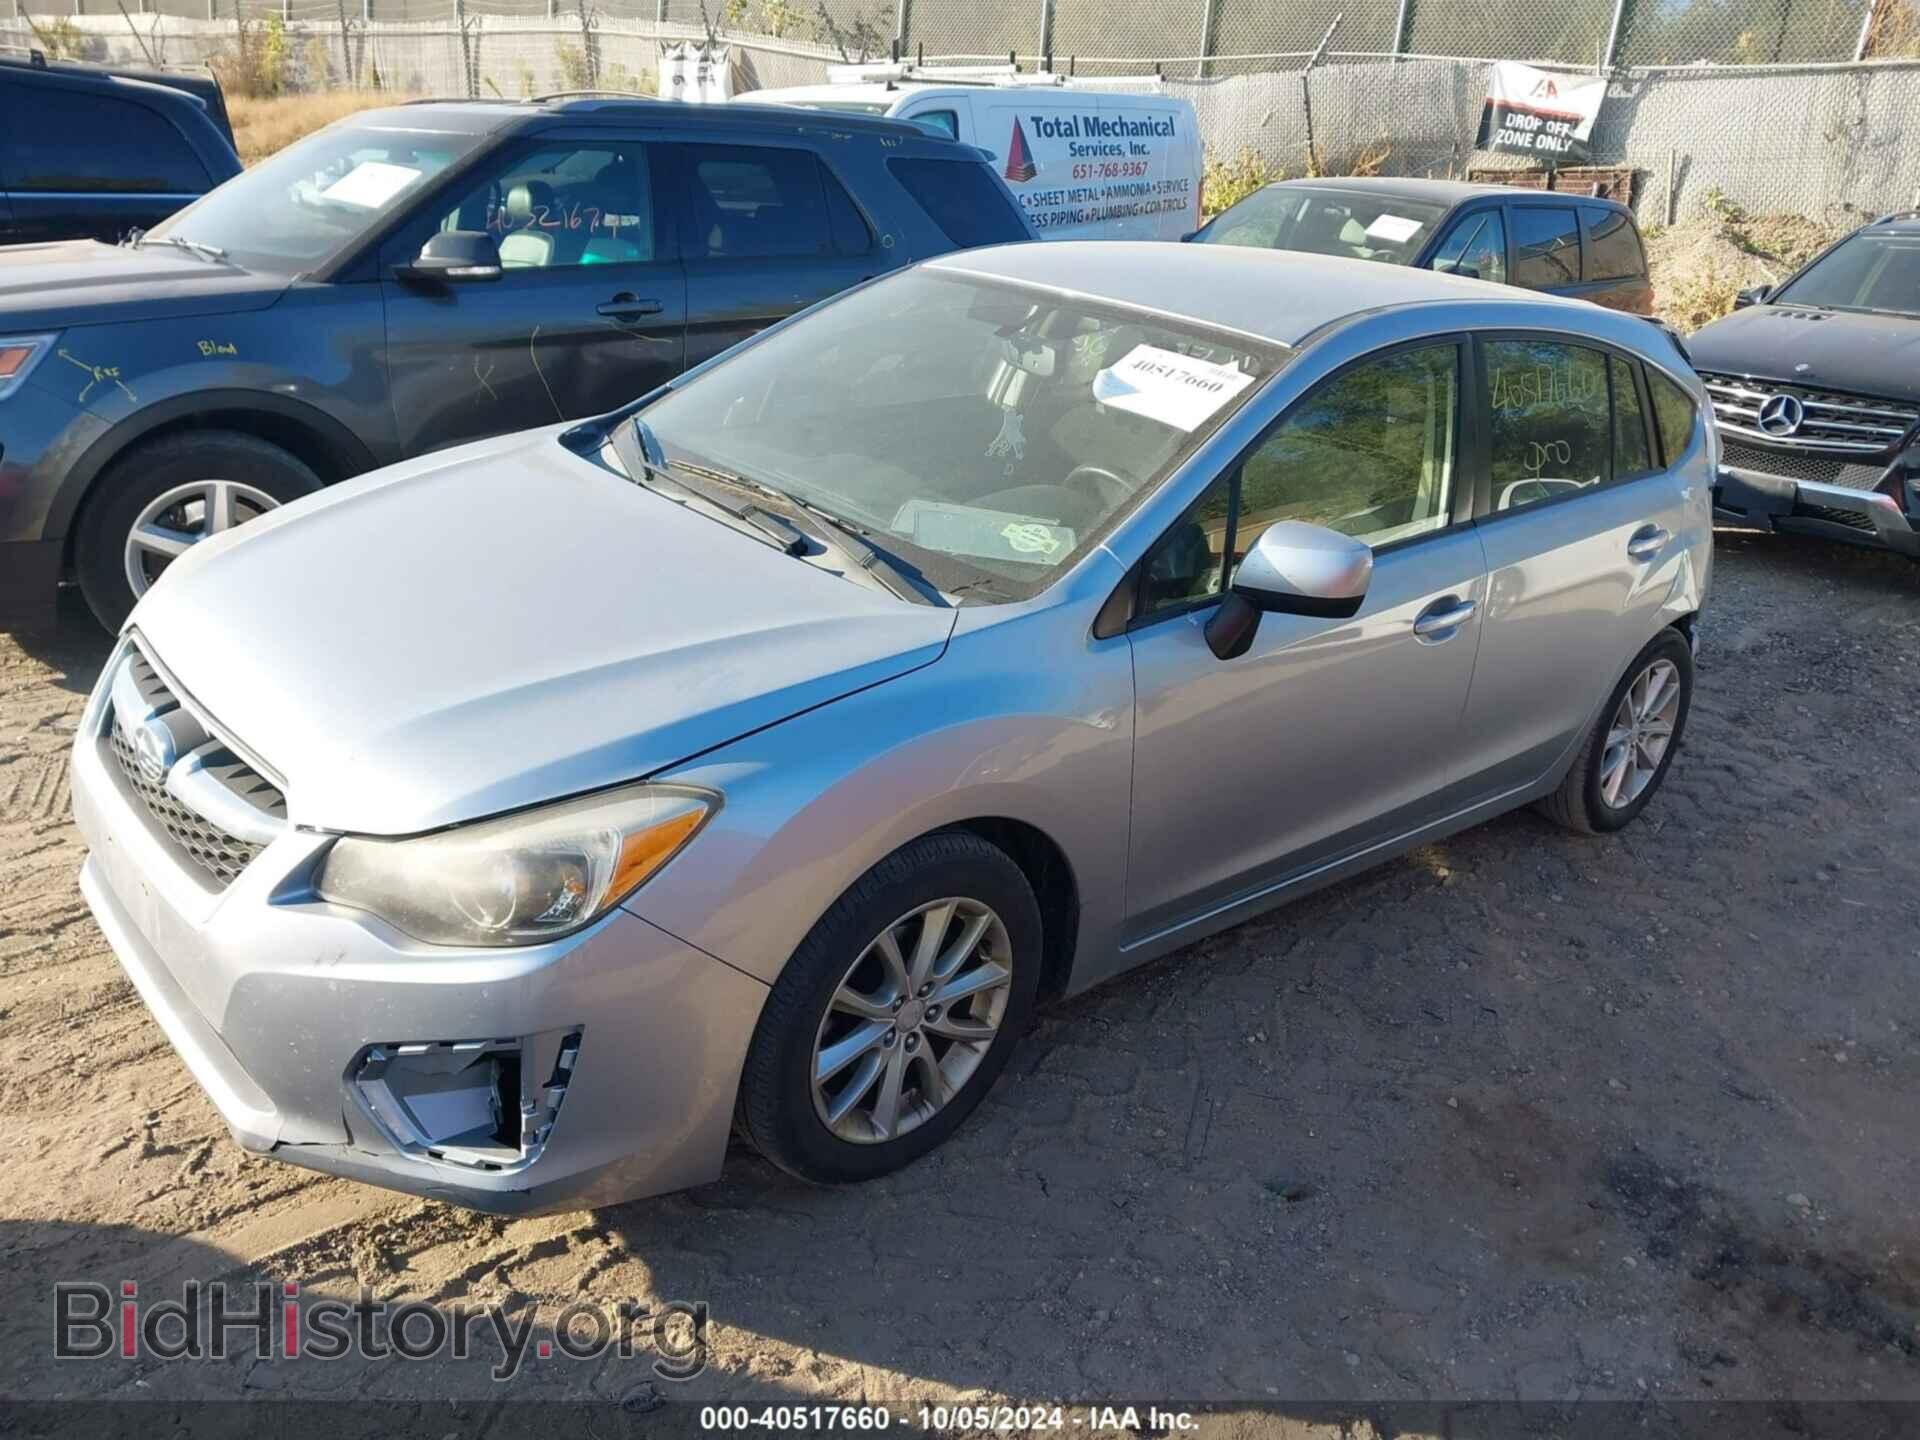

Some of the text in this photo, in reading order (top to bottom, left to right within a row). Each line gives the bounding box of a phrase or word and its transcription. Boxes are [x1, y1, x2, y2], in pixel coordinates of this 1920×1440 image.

[1030, 114, 1175, 138] Total Mechanical
[1505, 112, 1571, 138] DROP OFF
[1069, 141, 1150, 158] Services, Inc.
[1496, 129, 1573, 152] ZONE ONLY
[1072, 161, 1148, 179] 651-768-9367
[1033, 190, 1064, 207] SHEET
[1067, 188, 1100, 203] METAL
[1106, 181, 1151, 200] AMMONIA
[1157, 178, 1189, 194] SERVICE
[1050, 209, 1084, 225] PIPING
[1091, 203, 1138, 222] PLUMBING
[1144, 197, 1188, 215] CONTROLS
